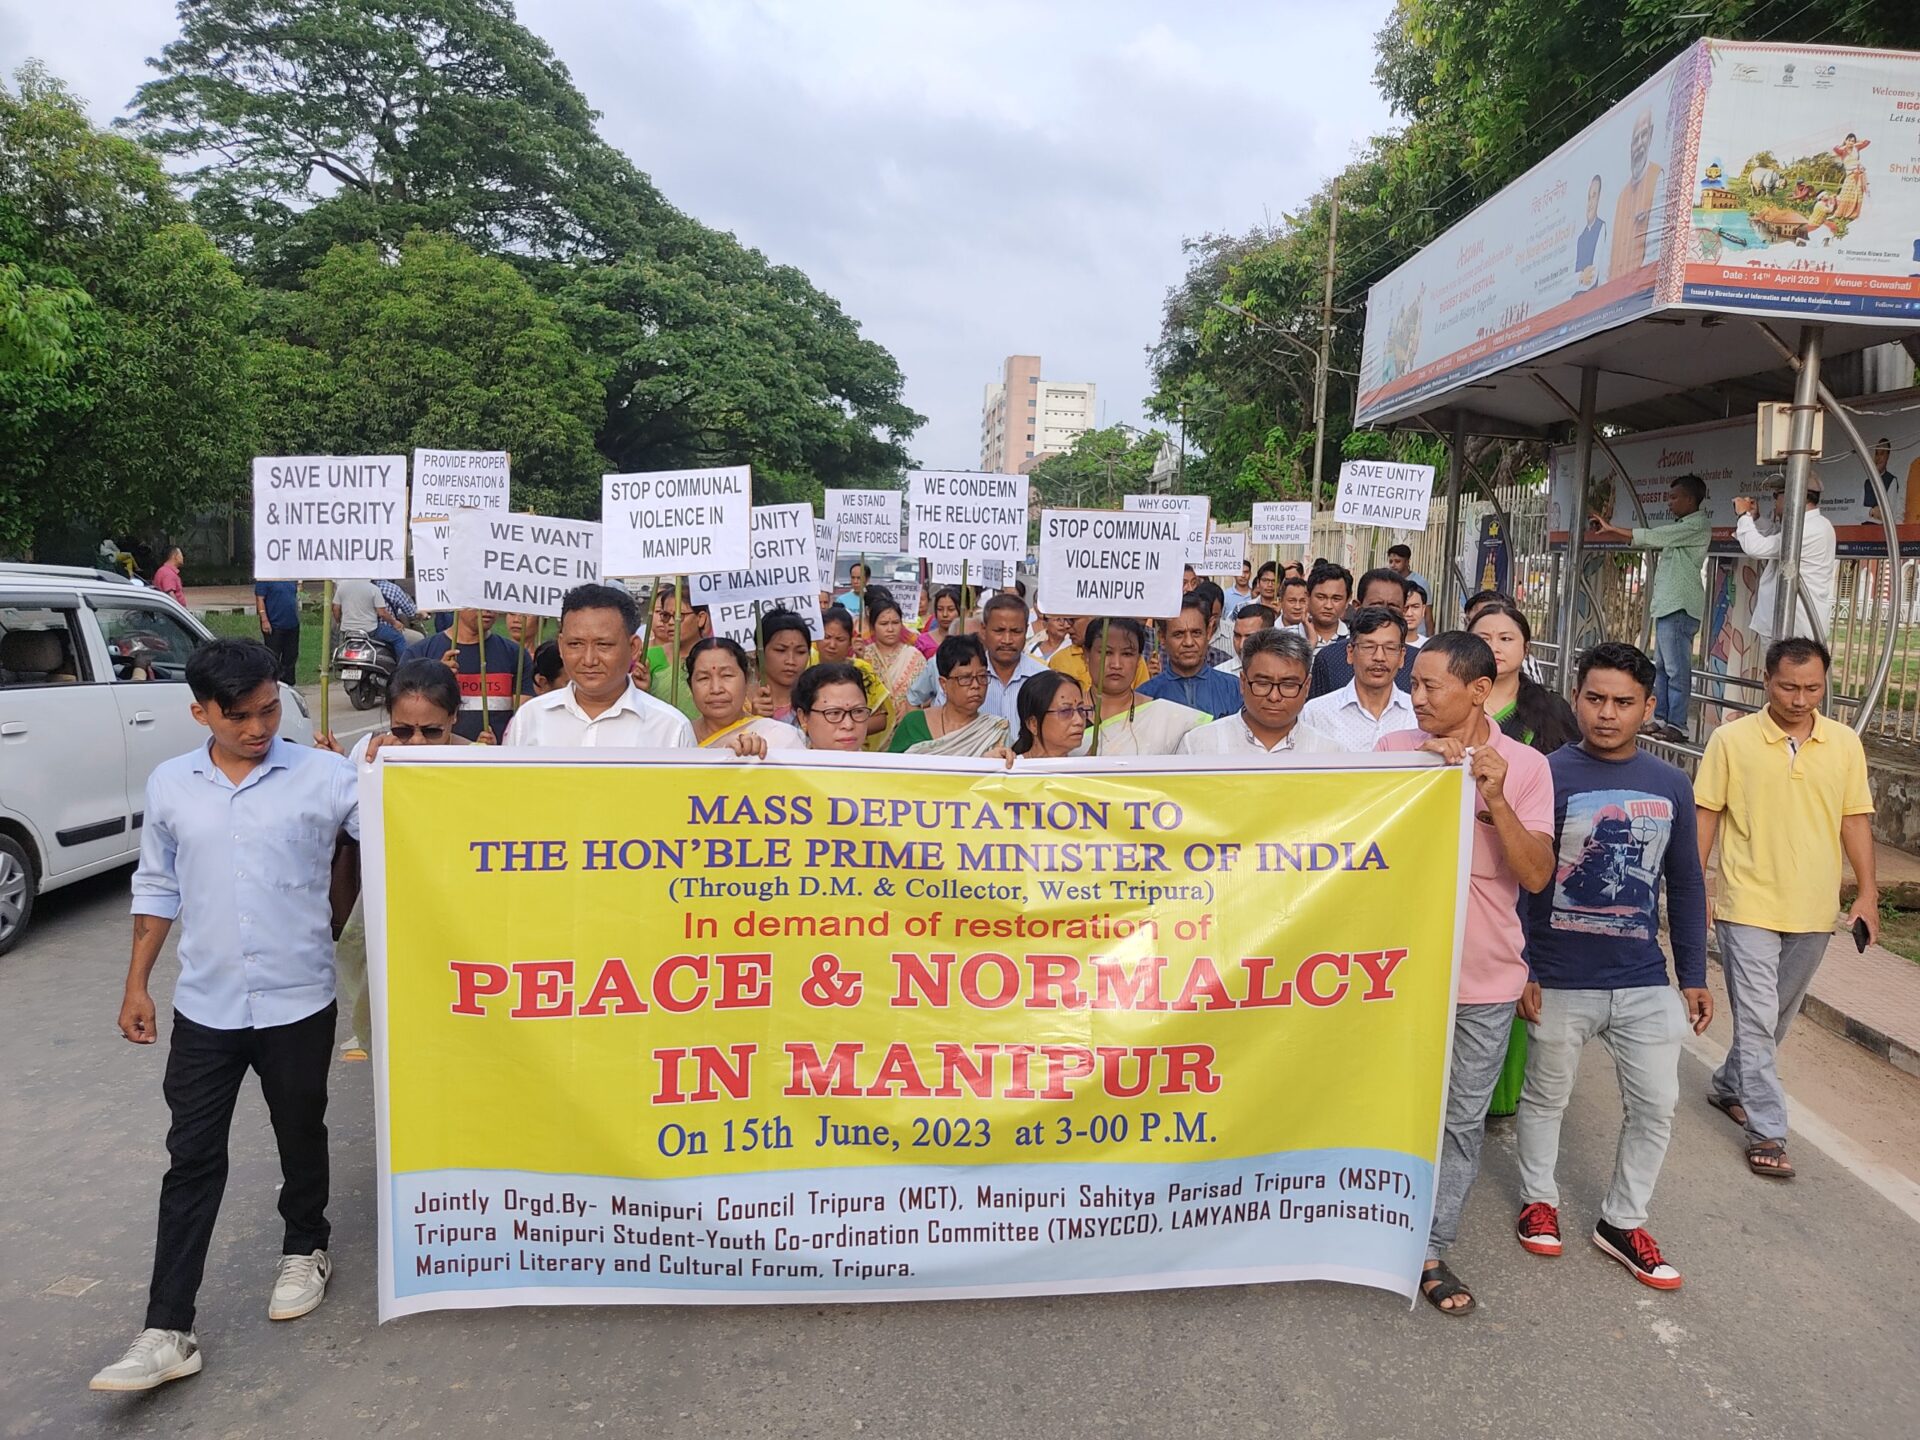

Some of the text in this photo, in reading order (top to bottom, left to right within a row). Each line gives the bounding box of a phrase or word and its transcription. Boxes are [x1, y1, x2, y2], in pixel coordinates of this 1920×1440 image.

[1872, 86, 1915, 97] Welcomes
[1889, 113, 1903, 122] Let
[1889, 163, 1908, 174] Shri
[1751, 272, 1770, 281] 14TH
[1774, 274, 1796, 284] April
[1798, 276, 1820, 285] 2023
[1869, 280, 1912, 290] Guwahati
[1750, 293, 1780, 302] Information
[1791, 295, 1807, 303] Public
[1834, 298, 1851, 306] Assam
[424, 454, 505, 469] PROVIDE PROPER
[270, 465, 391, 489] SAVE UNITY
[422, 473, 505, 489] COMPENSATION &
[1350, 464, 1425, 482] SAVE UNITY
[611, 475, 742, 501] STOP COMMUNAL
[924, 477, 1017, 498] WE CONDEMN
[1345, 482, 1425, 502] & INTEGRITY
[426, 493, 500, 508] RELIEFS TO THE
[842, 494, 885, 507] WE STAND
[1138, 499, 1190, 510] WHY GOVT.
[266, 501, 395, 525] & INTEGRITY
[630, 506, 724, 530] VIOLENCE IN
[836, 512, 891, 526] AGAINST ALL
[915, 504, 1025, 525] THE RELUCTANT
[1342, 501, 1421, 522] OF MANIPUR
[490, 522, 594, 549] WE WANT
[864, 532, 898, 544] FORCES
[1049, 518, 1181, 541] STOP COMMUNAL
[267, 538, 394, 561] OF MANIPUR
[643, 536, 712, 559] MANIPUR
[751, 538, 807, 560] GRITY
[919, 531, 1019, 552] ROLE OF GOVT.
[1210, 536, 1232, 546] STAND
[1066, 549, 1160, 570] VIOLENCE IN
[1223, 549, 1236, 558] ALL
[484, 549, 597, 581] PEACE IN
[936, 563, 974, 577] DIVISIE
[1215, 561, 1241, 570] FORCES
[699, 565, 811, 592] OF MANIPUR
[483, 580, 569, 606] MANIP
[1076, 580, 1145, 600] MANIPUR
[687, 795, 1183, 831] MASS DEPUTATION TO
[1630, 802, 1669, 818] FUTURO
[469, 840, 569, 873] THE
[804, 839, 945, 871] PRIME
[957, 842, 1171, 873] MINISTER
[1183, 842, 1242, 873] OF
[1256, 840, 1390, 872] INDIA
[668, 876, 1215, 906] (Through D.M. & Collector, West Tripura)
[684, 911, 1213, 942] In demand of restoration of
[449, 948, 1409, 1019] PEACE & NORMALCY
[651, 1041, 1222, 1105] IN MANIPUR
[658, 1111, 1217, 1157] On 15th June, 2023 at 3-00 P.M.
[414, 1166, 1416, 1221] Jointly Orgd.By- Manipuri Council Tripura (MCT), Manipuri Sahitya Parisad Tripura (MSPT),
[414, 1199, 1415, 1251] Tripura Manipuri Student-Youth Co-ordination Committee (TMSYCCO), LAMYANBA Organisation,
[416, 1250, 916, 1280] Manipuri Literary and Cultural Forum, Tripura.
